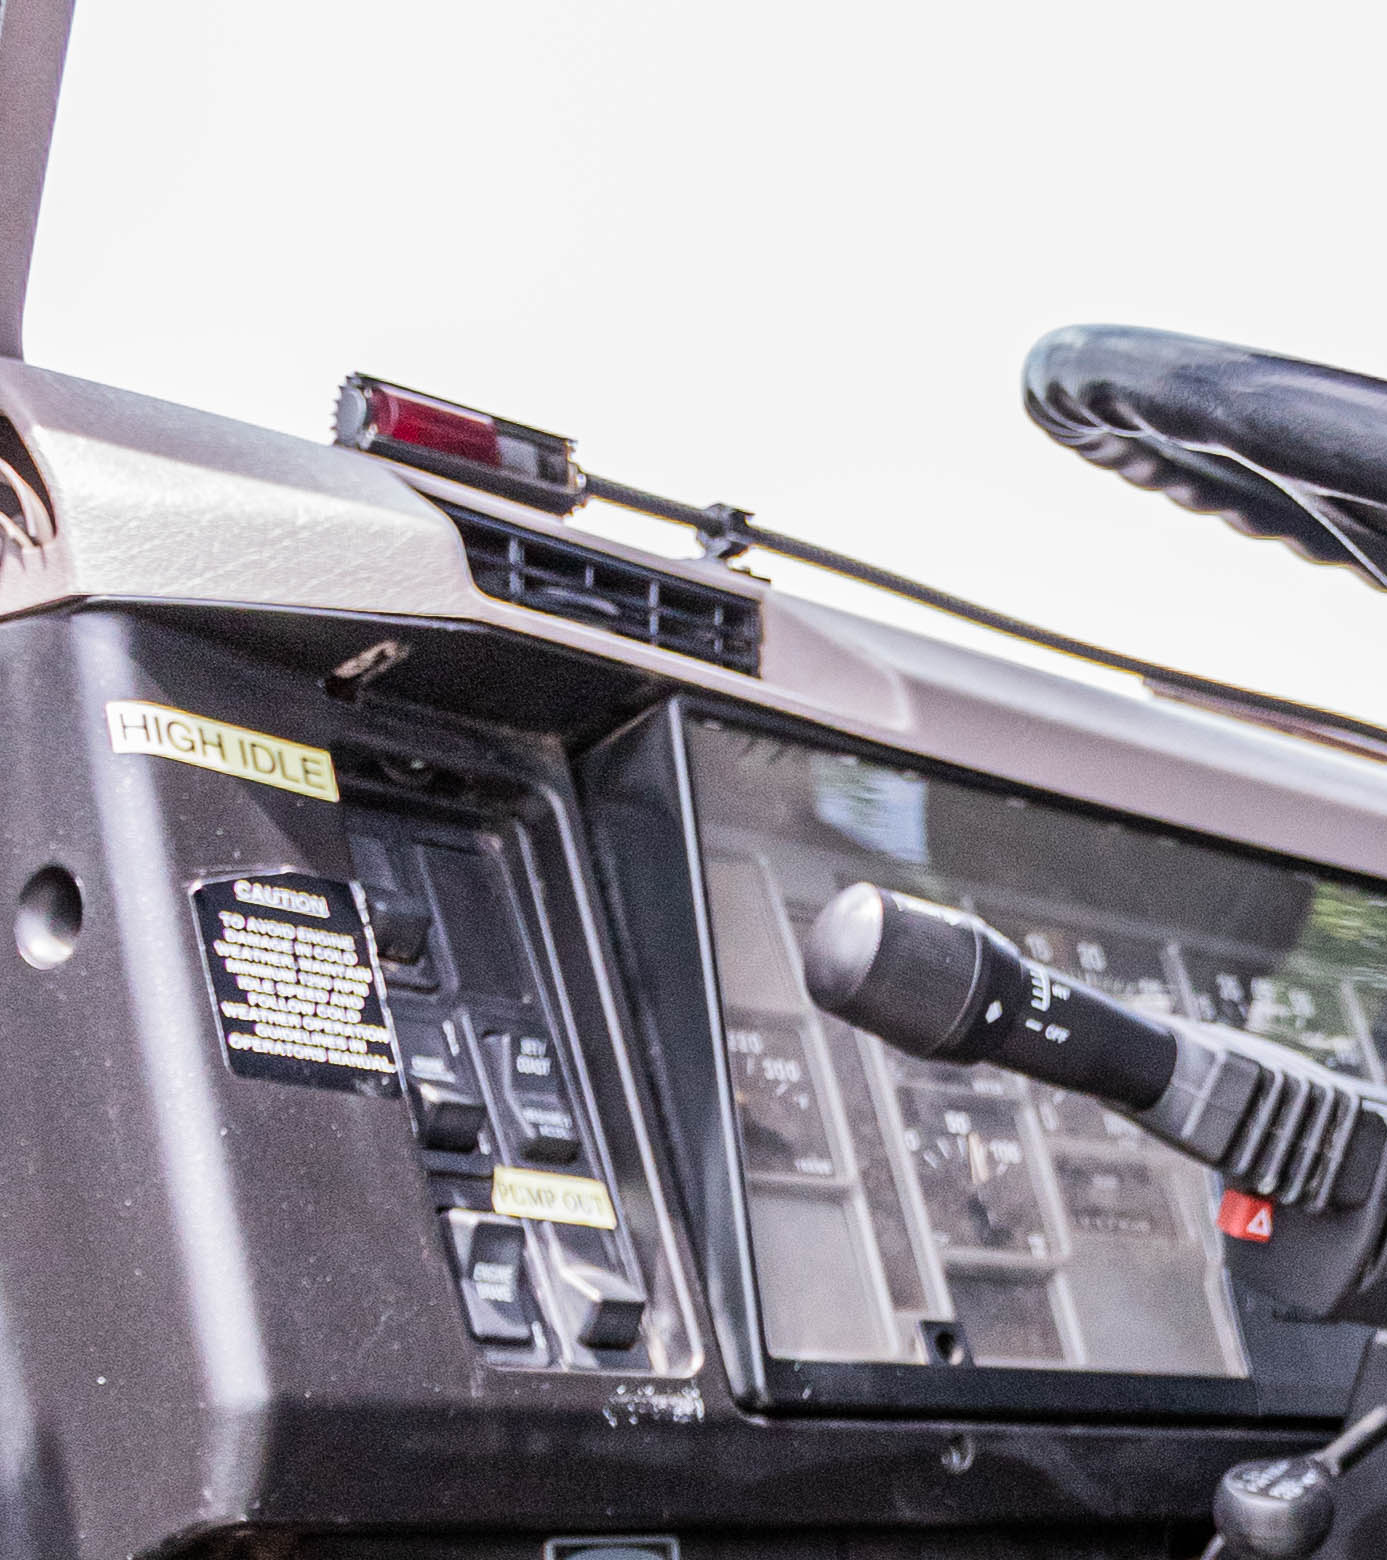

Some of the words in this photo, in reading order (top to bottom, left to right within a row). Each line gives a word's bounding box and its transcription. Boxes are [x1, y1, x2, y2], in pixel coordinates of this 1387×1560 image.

[119, 712, 226, 763] HIGH
[238, 737, 328, 791] IDLE
[233, 879, 331, 917] CAUTION
[496, 1181, 556, 1209] PUMP
[562, 1189, 604, 1217] OUT
